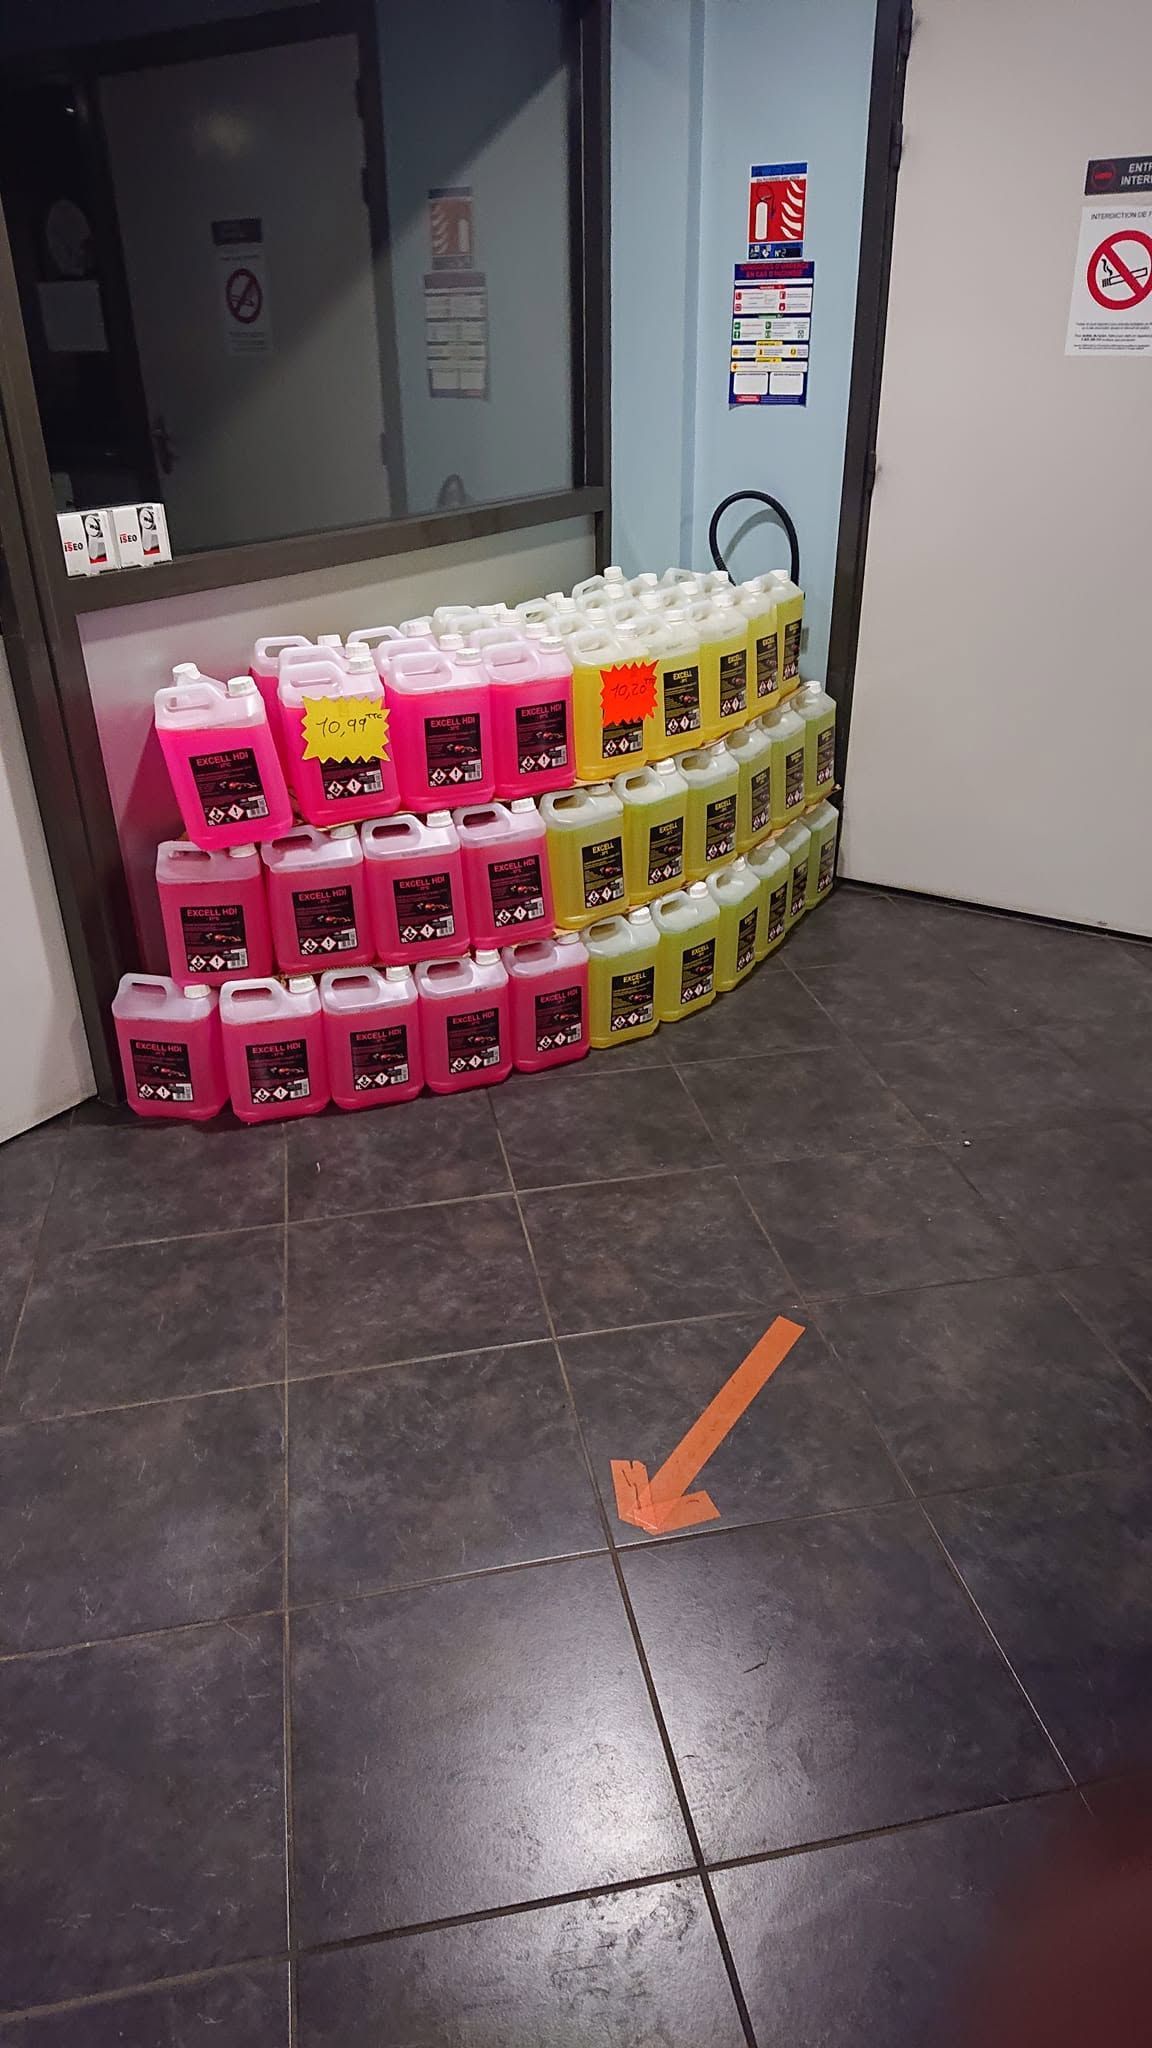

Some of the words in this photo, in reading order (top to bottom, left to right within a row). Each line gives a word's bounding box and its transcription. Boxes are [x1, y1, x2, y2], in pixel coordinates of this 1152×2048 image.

[1120, 175, 1152, 185] INTER
[120, 532, 138, 544] ISEO
[64, 541, 84, 553] ISEO
[610, 683, 646, 701] 10,20
[521, 706, 549, 717] EXCELL
[550, 703, 562, 712] HDI
[316, 717, 366, 738] 10,99
[430, 718, 461, 728] EXCELL
[462, 716, 475, 724] HDI
[196, 754, 232, 766] EXCELL
[233, 752, 249, 762] HDI
[494, 862, 523, 872] EXCELL
[523, 858, 536, 867] HDI
[399, 879, 431, 889] EXCELL
[432, 876, 445, 884] HDI
[298, 893, 331, 902] EXCELL
[332, 889, 347, 897] HDI
[540, 992, 566, 1003] EXCELL
[452, 1014, 480, 1024] EXCELL
[356, 1031, 387, 1041] EXCELL
[388, 1028, 402, 1036] HDI
[136, 1042, 167, 1052] EXCELL
[168, 1044, 182, 1052] HDI
[252, 1045, 286, 1054] EXCELL
[286, 1042, 301, 1051] HDI
